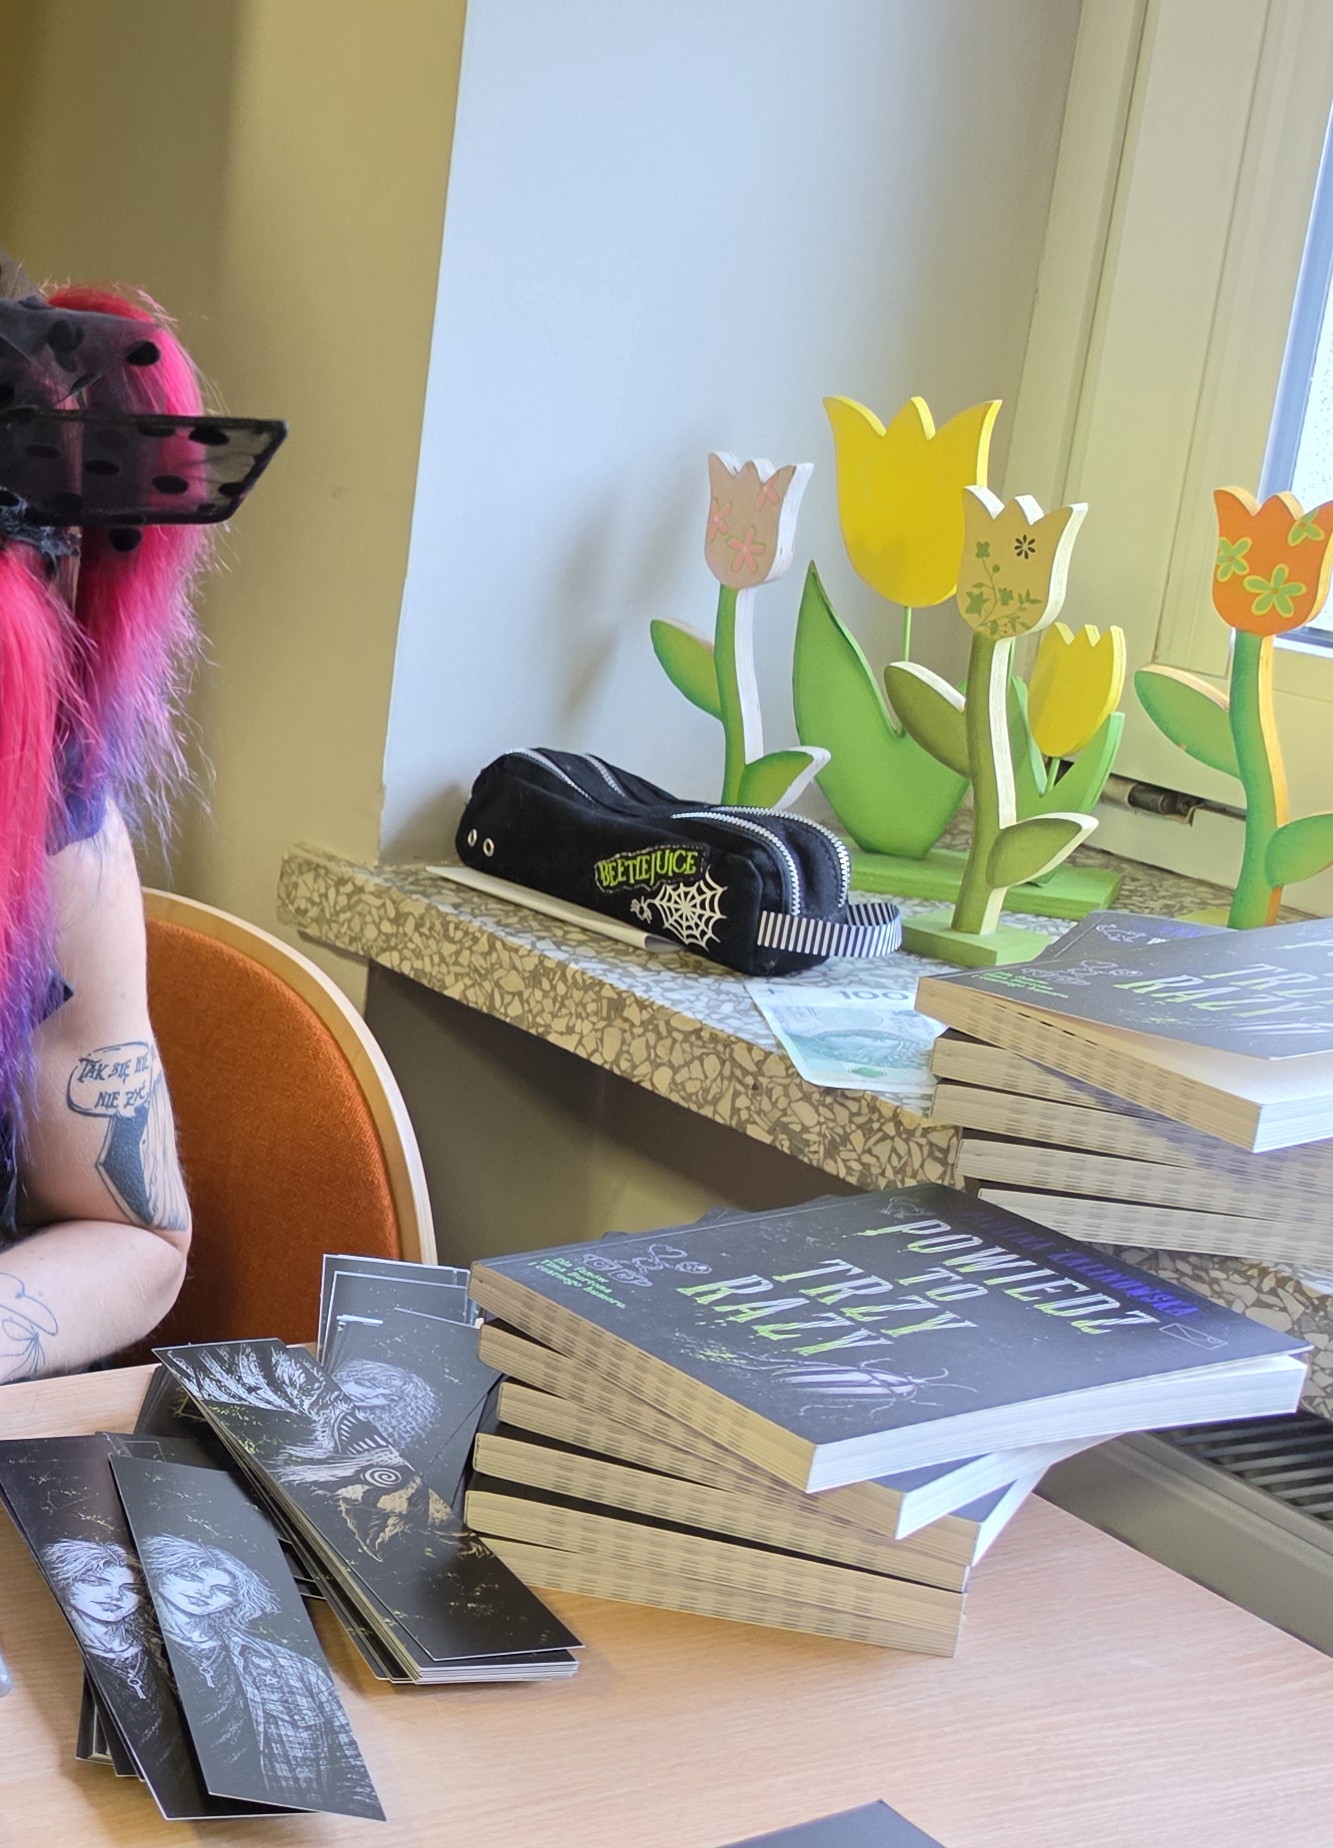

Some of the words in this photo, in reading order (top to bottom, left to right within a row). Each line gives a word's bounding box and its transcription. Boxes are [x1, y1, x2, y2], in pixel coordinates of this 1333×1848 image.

[598, 849, 699, 886] BEETLEJUICE
[839, 990, 910, 1001] 100
[1113, 974, 1326, 1018] RAZY
[77, 1057, 109, 1083] TAK
[107, 1059, 132, 1085] SIĘ
[94, 1090, 121, 1109] NIE
[843, 1218, 1161, 1336] POWIEDZ
[894, 1267, 989, 1302] TO
[1046, 1251, 1199, 1317] KALINOWSKA
[676, 1274, 893, 1357] RAZY
[771, 1258, 979, 1338] TRZY
